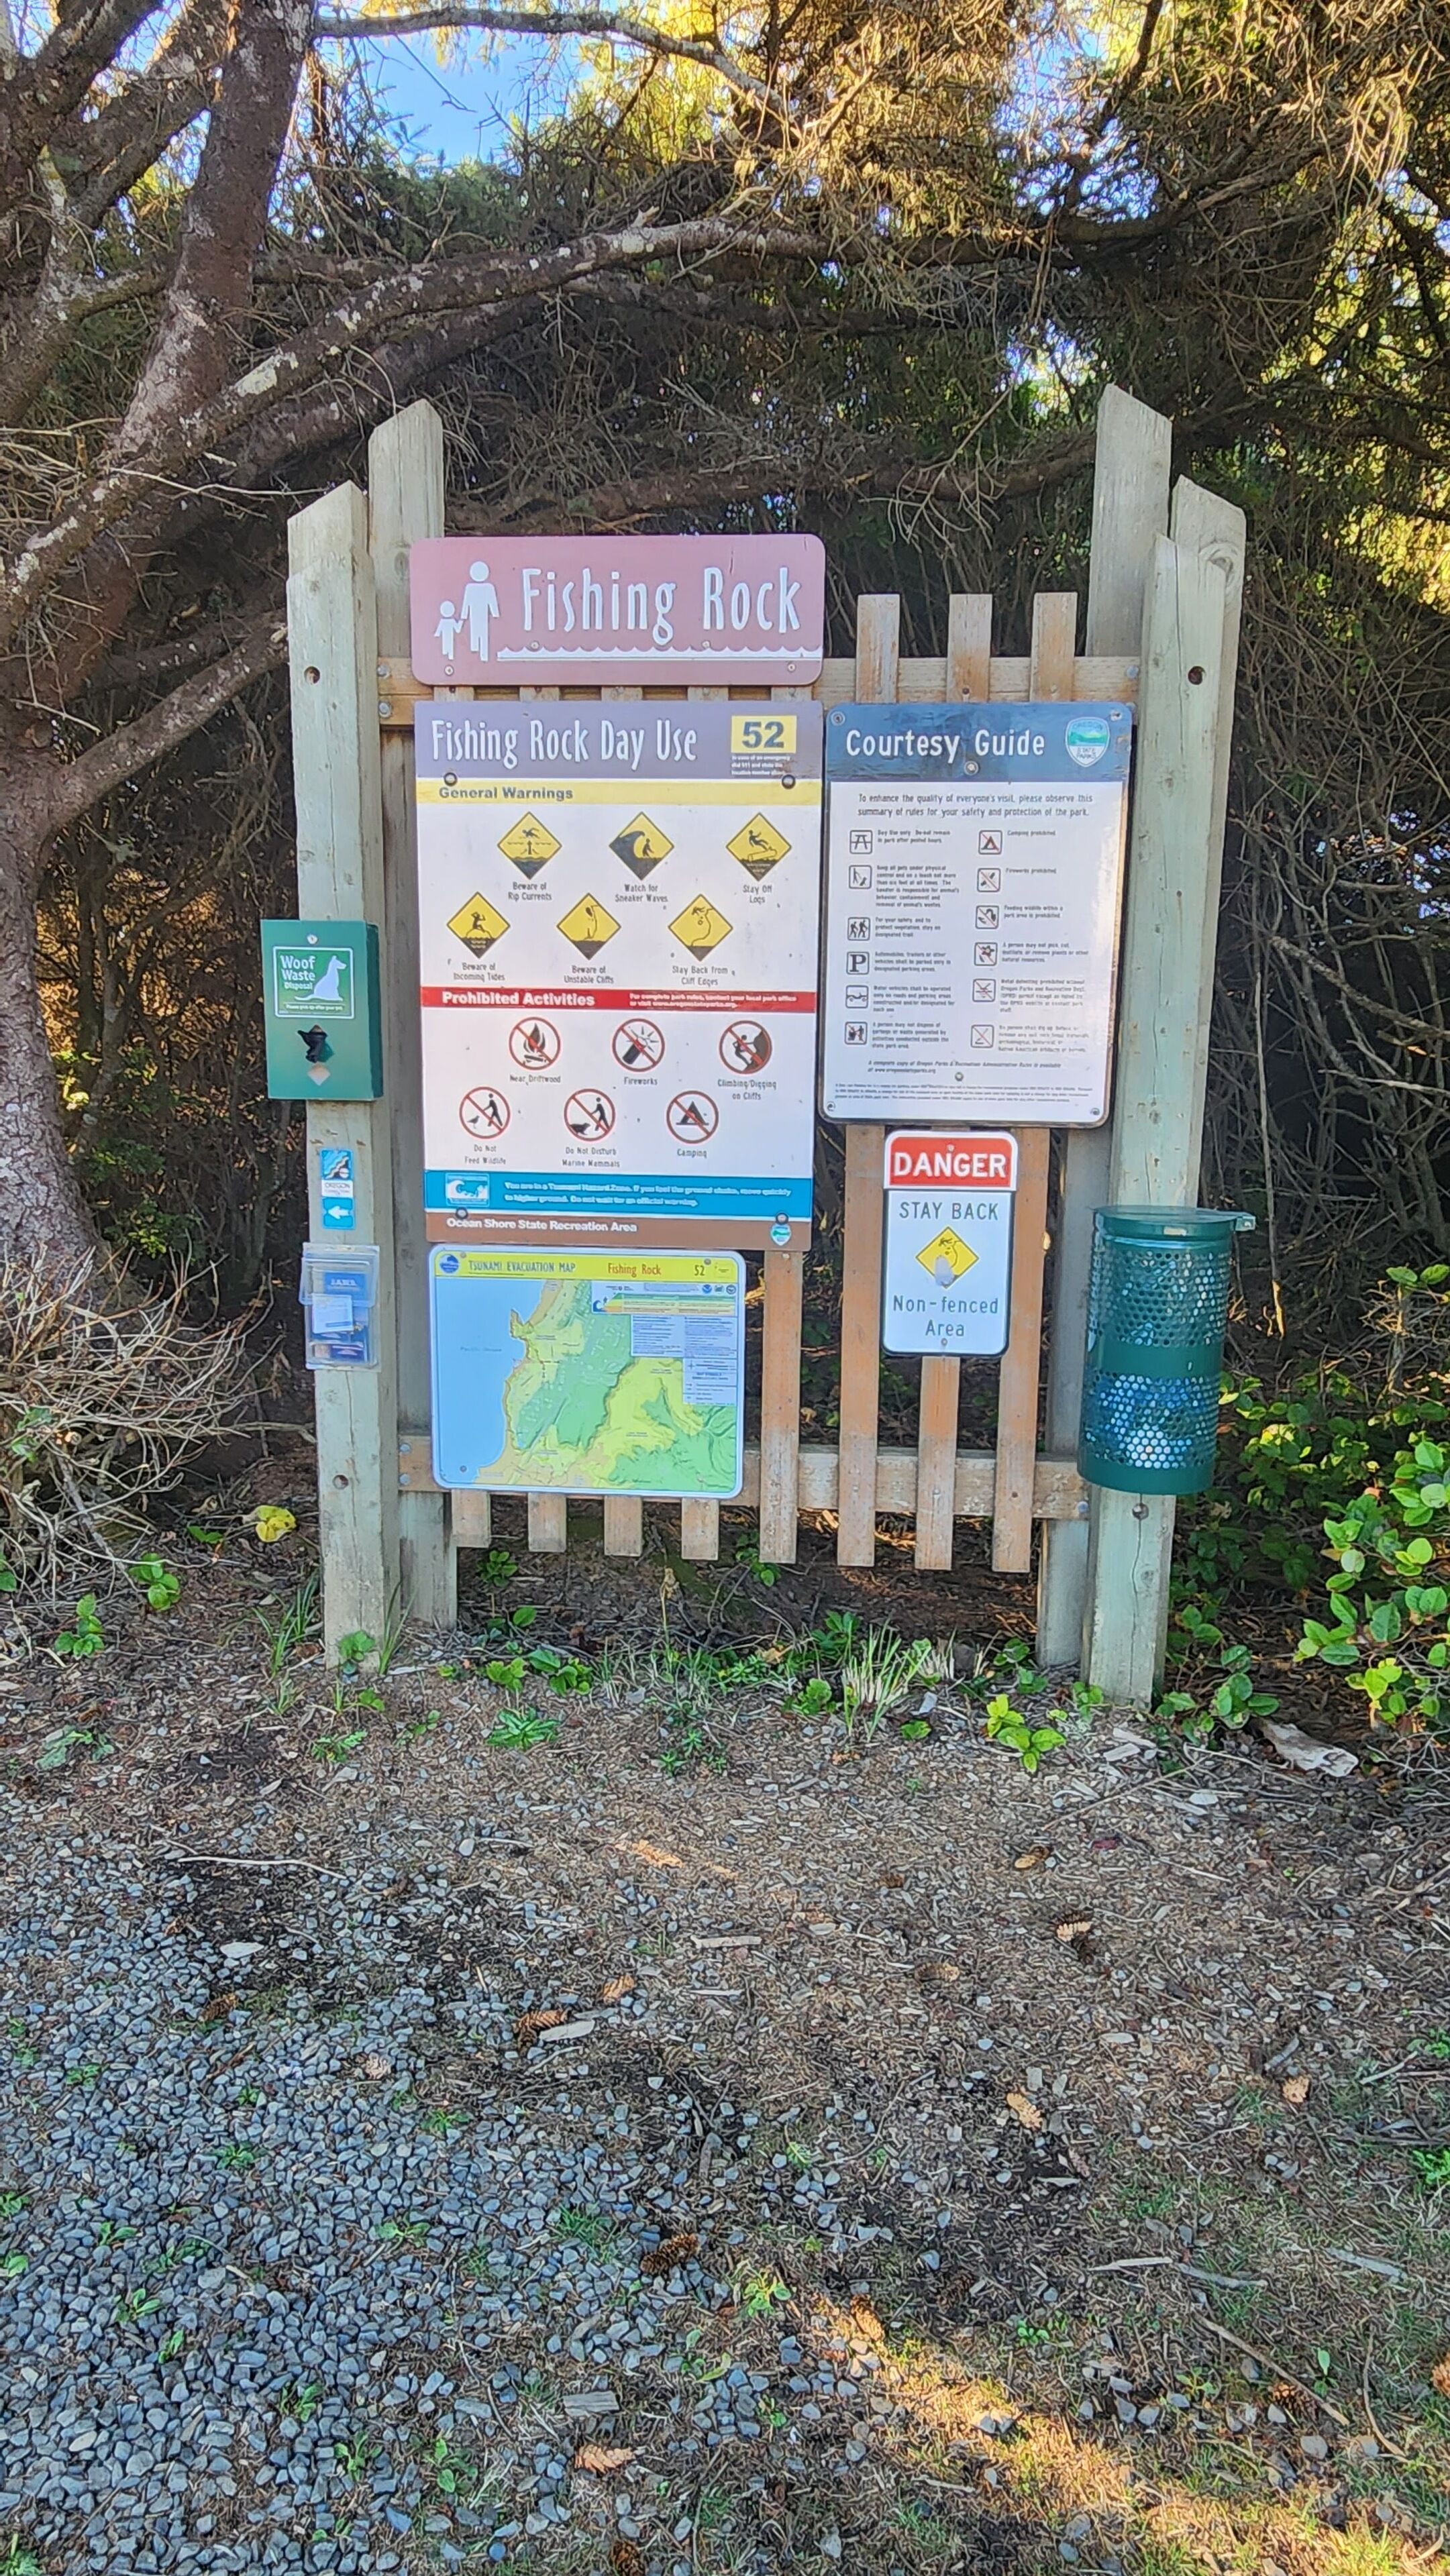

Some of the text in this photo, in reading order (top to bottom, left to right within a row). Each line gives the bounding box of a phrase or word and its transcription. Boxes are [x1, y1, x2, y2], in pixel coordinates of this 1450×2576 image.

[523, 567, 801, 645] Fishing Rock
[742, 721, 784, 749] 52
[432, 719, 696, 770] Fishing Rock Day Use
[846, 729, 1045, 763] Courtesy Guide
[439, 787, 573, 802] General Warnings
[859, 794, 1092, 805] To enhance the quality of everyone's visit, please observe this
[858, 807, 1088, 819] summary of rules for your safety and protection of the park.
[624, 884, 645, 892] Watch
[742, 885, 772, 895] Stay Off
[508, 892, 552, 902] Rip Currents
[749, 895, 766, 904] Logs
[280, 955, 315, 969] Woof
[462, 963, 495, 971] Beware of
[572, 965, 606, 973] Beware of
[672, 966, 688, 975] Stay
[281, 969, 315, 981] Waste
[453, 973, 505, 982] Incoming Tides
[564, 975, 614, 983] Unstable Cliffs
[284, 982, 313, 990] Disposal
[681, 977, 718, 987] Cliff Edges
[442, 991, 595, 1006] Prohibited Activities
[529, 1075, 560, 1083] Driftwood
[624, 1077, 658, 1085] Fireworks
[717, 1079, 776, 1089] Climbing/Digging
[743, 1091, 761, 1100] Cliffs
[592, 1147, 616, 1155] Disturb
[677, 1148, 707, 1158] Camping
[482, 1157, 506, 1165] Wildlife
[588, 1159, 619, 1167] Mammals
[894, 1152, 1006, 1178] DANGER
[762, 1189, 792, 1197] quickly
[899, 1202, 998, 1220] STAY BACK
[446, 1218, 637, 1232] Ocean Shore State Recreation Area
[469, 1261, 502, 1271] TSUNAMI
[507, 1262, 554, 1272] EVACUATION
[559, 1263, 576, 1273] MAP
[608, 1263, 661, 1277] Fishing Rock
[694, 1265, 705, 1275] 52
[893, 1295, 998, 1313] Non-fenced
[925, 1320, 964, 1336] Area
